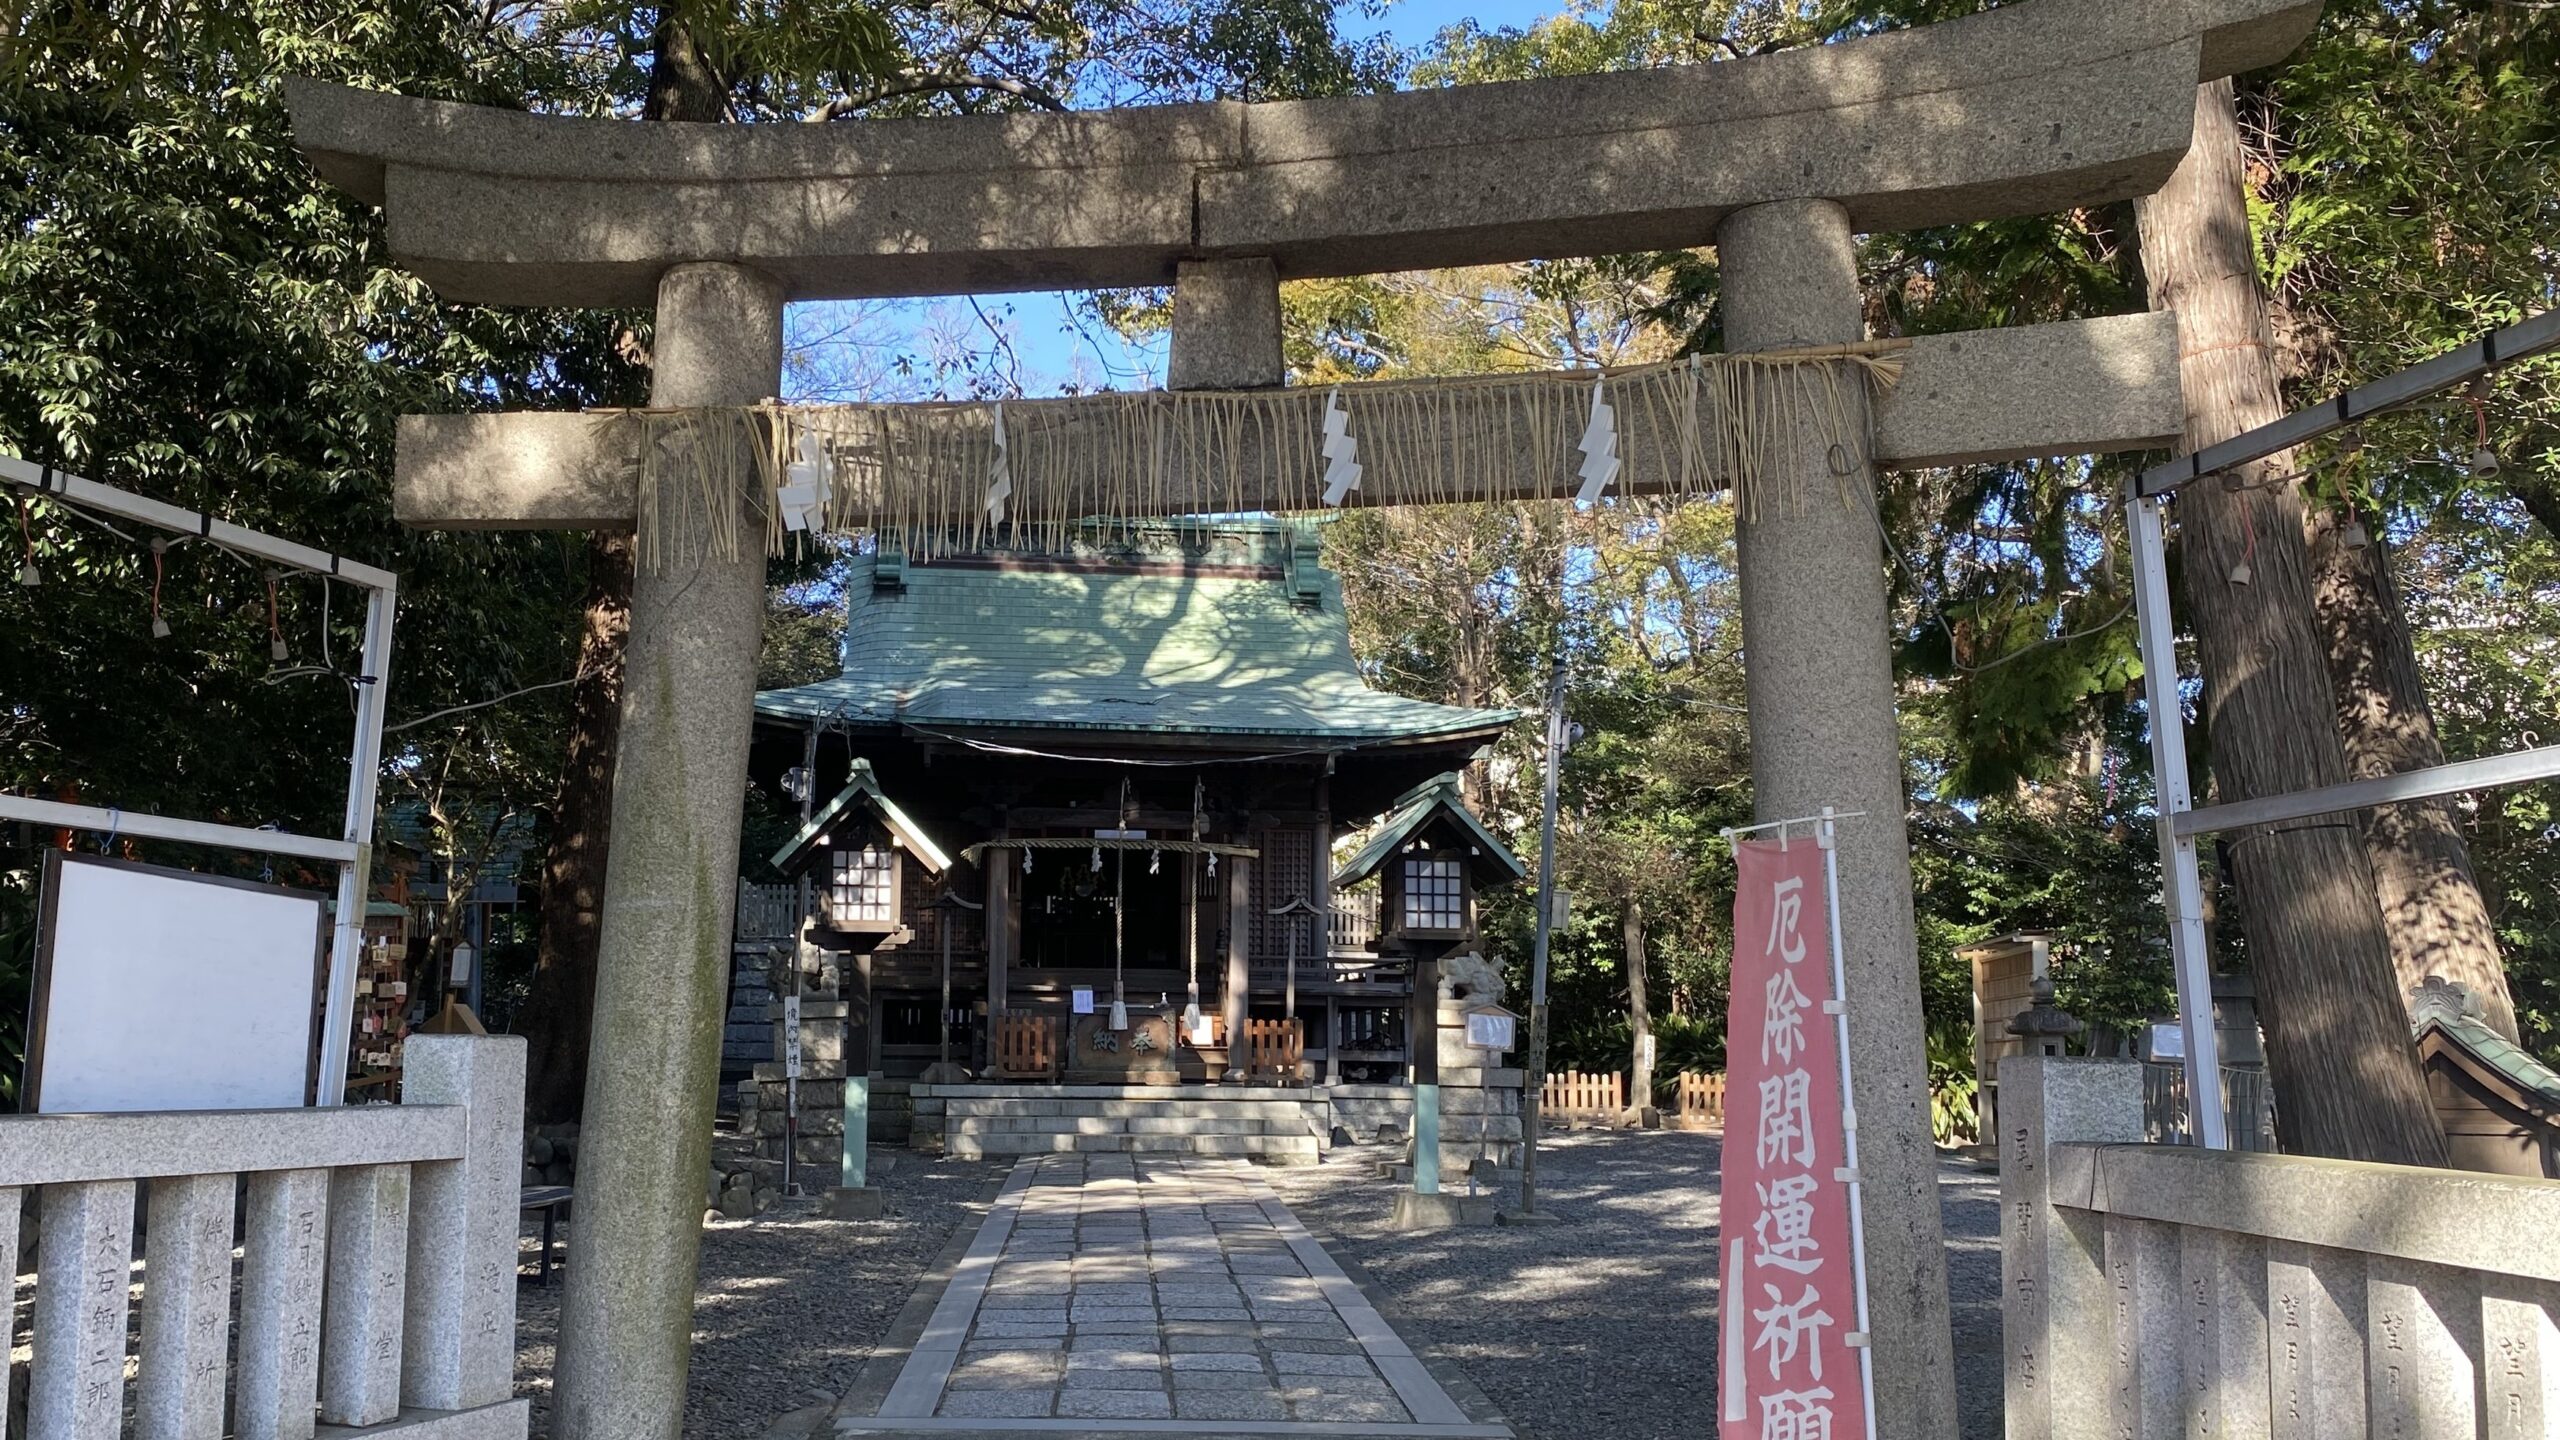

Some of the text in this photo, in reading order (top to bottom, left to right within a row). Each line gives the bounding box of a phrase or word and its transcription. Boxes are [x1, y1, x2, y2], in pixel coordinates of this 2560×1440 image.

[786, 1007, 799, 1066] 境内禁煙
[1753, 875, 1835, 1440] 厄除開運祈願
